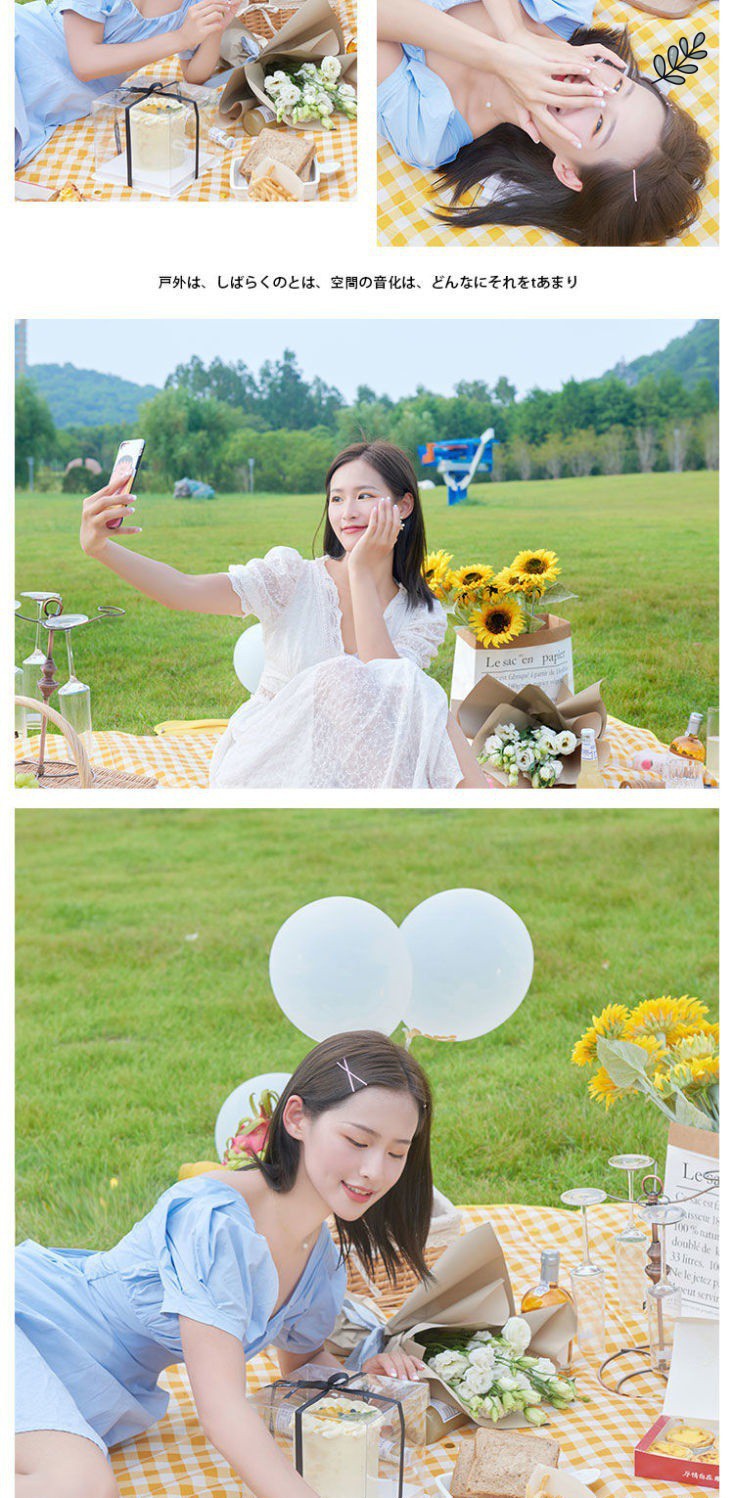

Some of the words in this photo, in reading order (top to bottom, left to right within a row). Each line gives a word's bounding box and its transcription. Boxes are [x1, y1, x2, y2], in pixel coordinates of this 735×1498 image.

[486, 656, 501, 668] Le
[521, 656, 534, 664] en
[683, 1162, 703, 1183] Le
[674, 1222, 689, 1233] 100
